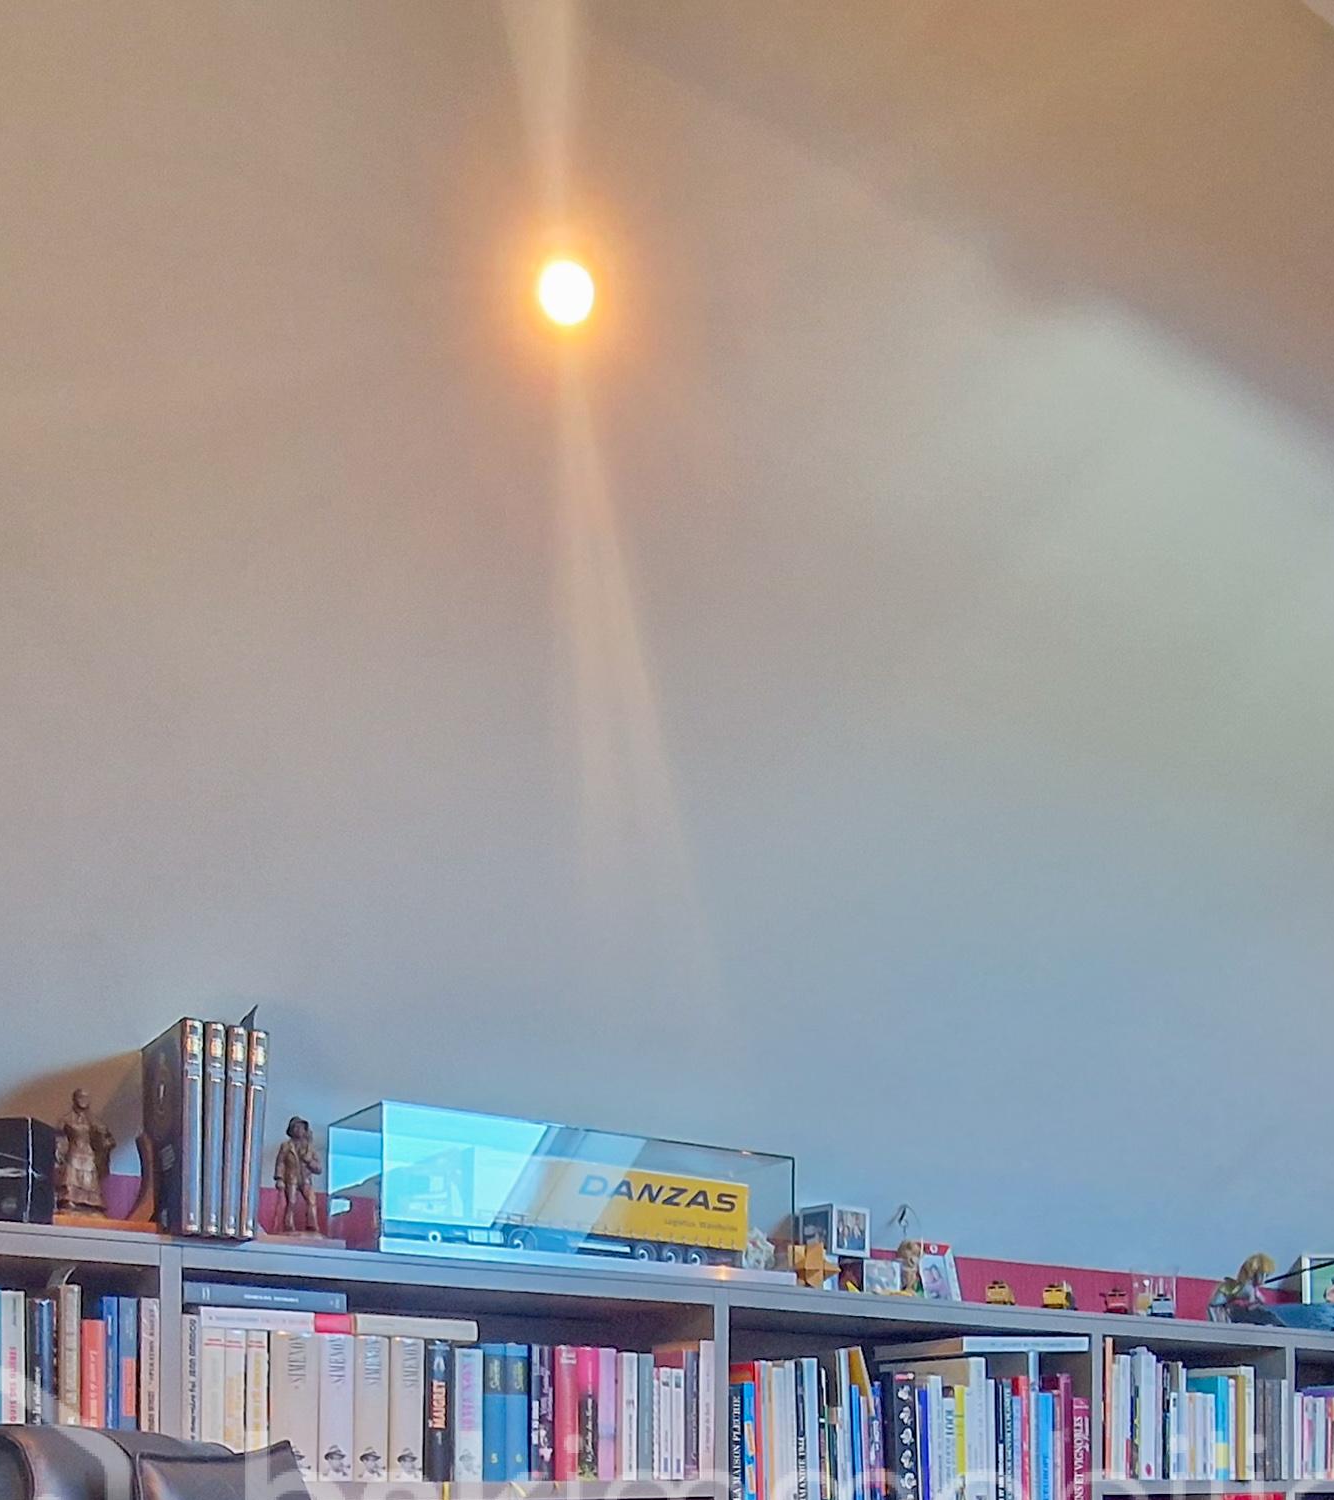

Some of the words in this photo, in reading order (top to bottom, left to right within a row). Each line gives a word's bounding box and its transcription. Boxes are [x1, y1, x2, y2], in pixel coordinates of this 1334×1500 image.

[579, 1174, 738, 1212] DANZAS
[287, 1335, 307, 1384] SIMENON
[328, 1336, 346, 1385] SIMENON
[363, 1338, 382, 1387] SIMENON
[402, 1341, 419, 1389] SIMENON
[9, 1401, 17, 1421] QUIS
[432, 1379, 446, 1428] MAIGRET
[732, 1396, 741, 1441] FLEURIE
[1074, 1416, 1085, 1469] VIGNOBLES
[733, 1489, 741, 1500] LA
[1074, 1473, 1083, 1484] ET
